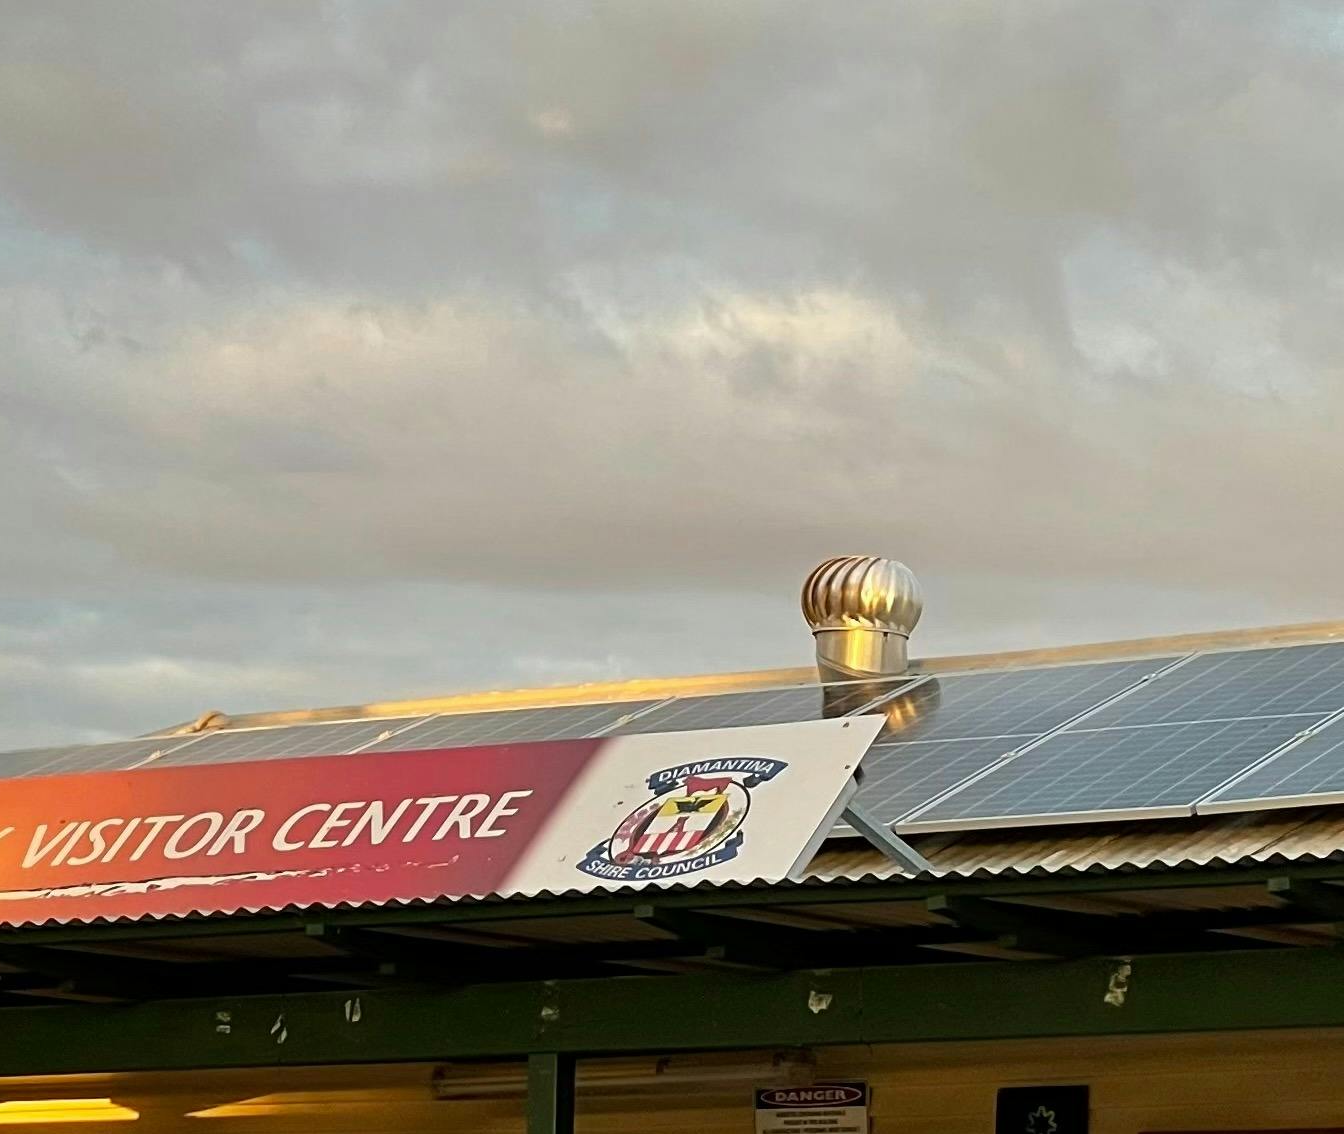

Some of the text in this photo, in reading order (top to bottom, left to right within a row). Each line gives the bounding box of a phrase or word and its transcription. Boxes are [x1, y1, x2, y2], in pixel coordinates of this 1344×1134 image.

[657, 758, 776, 784] DIAMANTINA
[22, 809, 266, 869] VISITOR
[272, 789, 534, 851] CENTRE
[585, 854, 723, 880] SHIRE COUNCIL
[775, 1090, 847, 1102] DANGER
